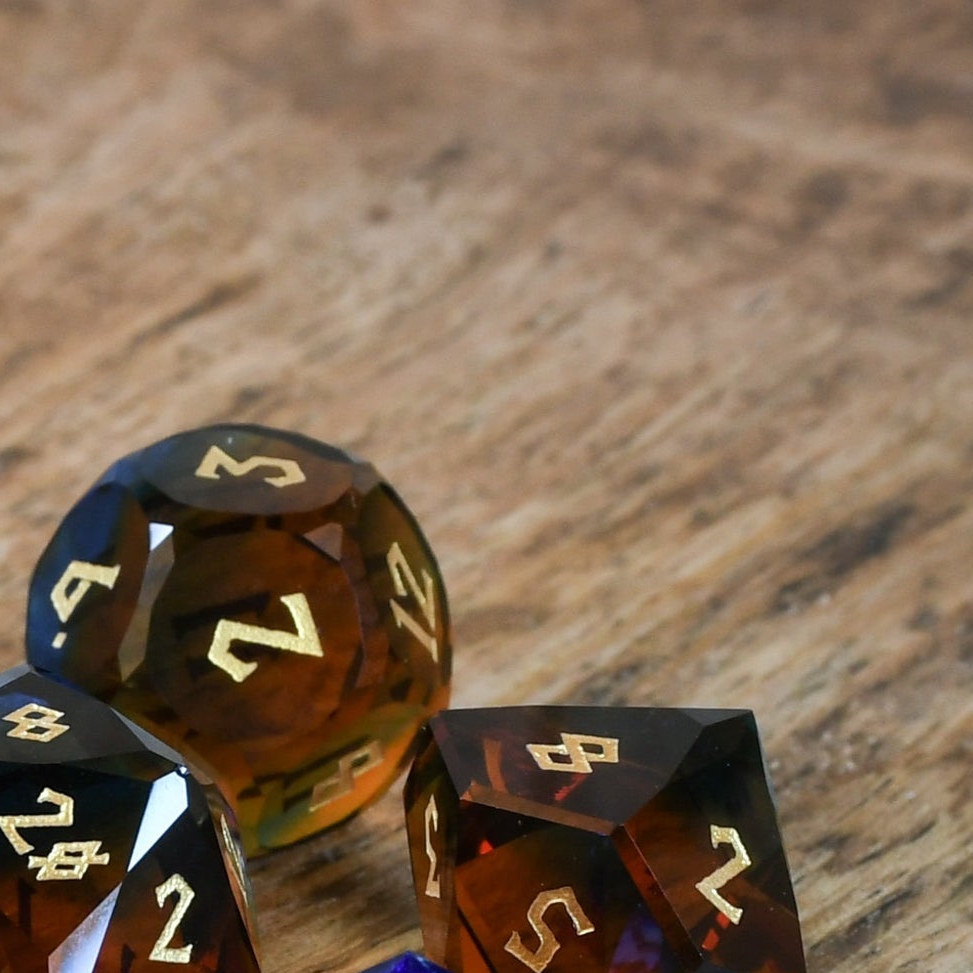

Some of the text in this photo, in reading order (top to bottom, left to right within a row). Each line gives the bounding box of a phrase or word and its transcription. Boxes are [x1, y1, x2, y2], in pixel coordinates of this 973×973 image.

[195, 445, 306, 488] 3
[207, 593, 324, 683] 2
[2, 703, 70, 742] 8
[527, 732, 619, 773] 8
[695, 824, 751, 926] 2
[149, 873, 195, 964] 2
[504, 887, 595, 973] 5
